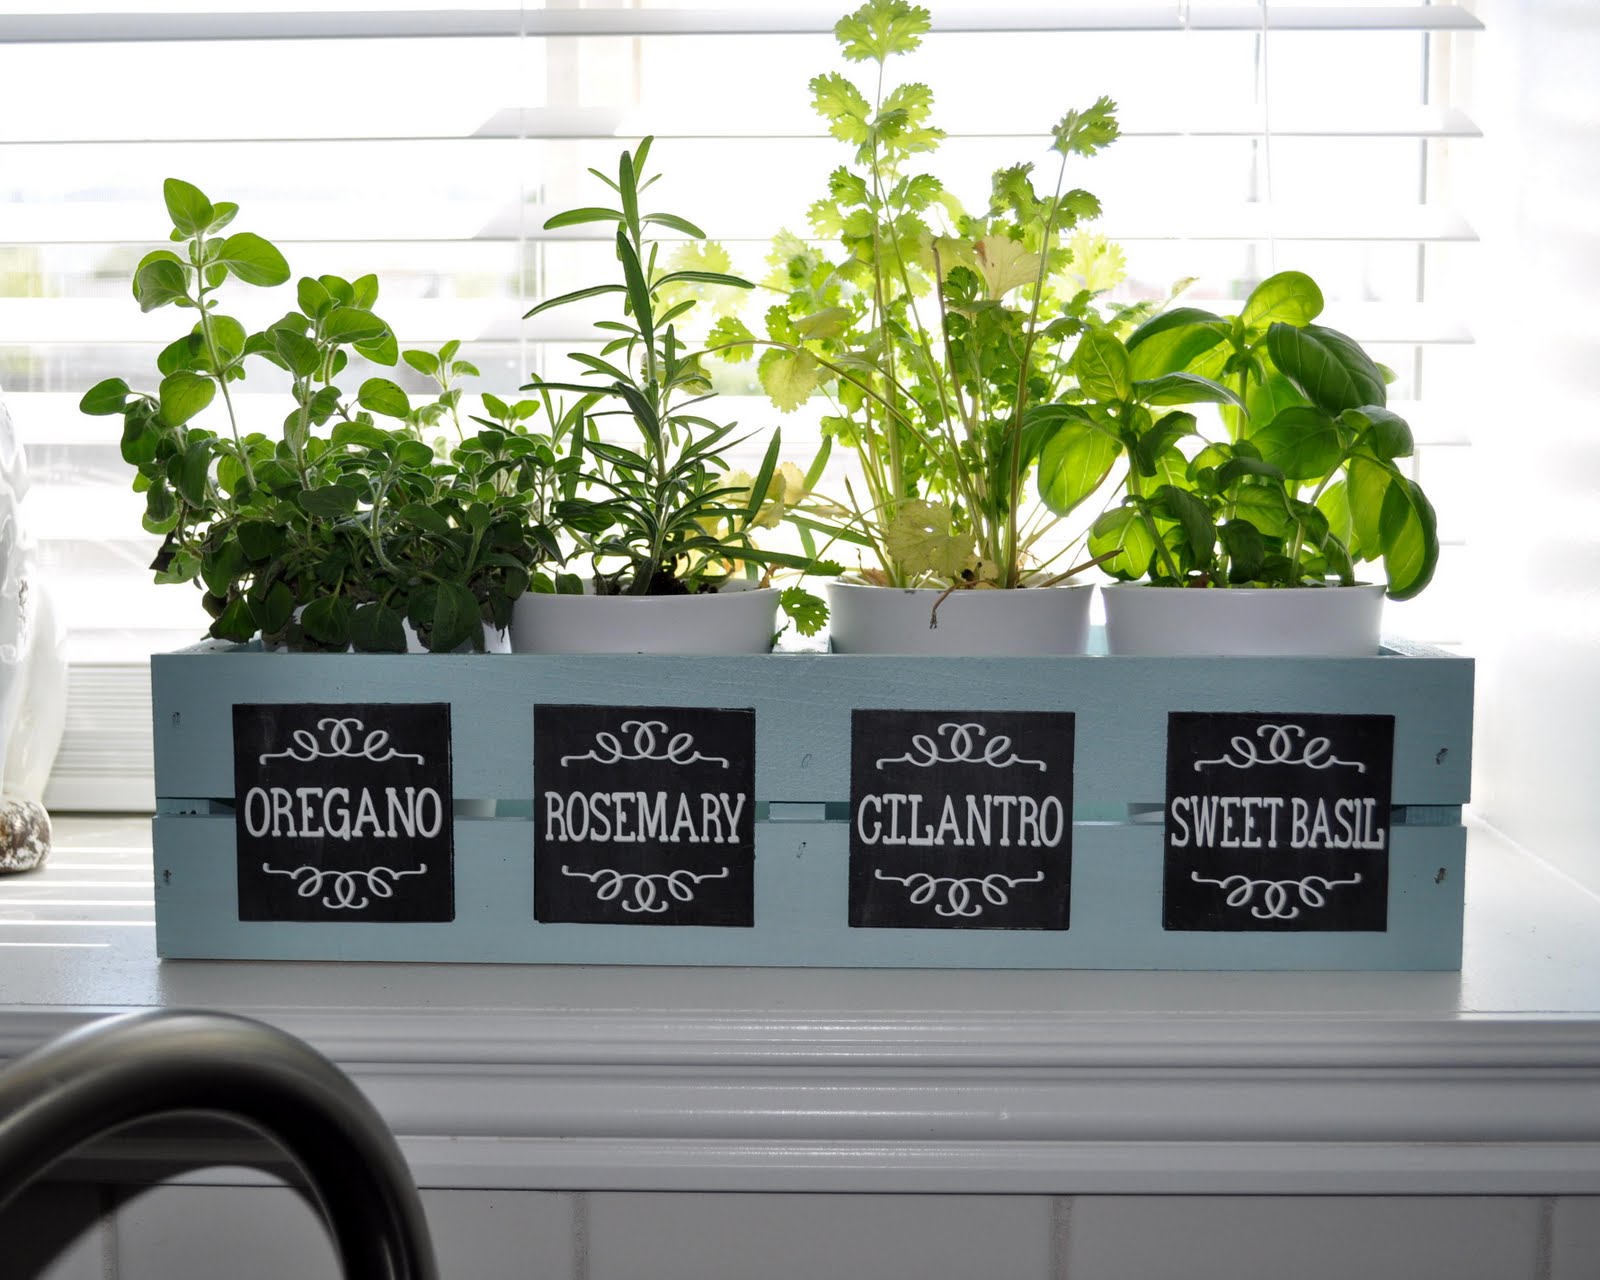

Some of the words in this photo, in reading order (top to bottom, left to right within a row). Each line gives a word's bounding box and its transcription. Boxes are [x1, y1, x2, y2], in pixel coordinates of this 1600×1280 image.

[244, 786, 443, 841] OREGANO
[544, 791, 746, 844] ROSEMARY
[857, 793, 1064, 848] CILANTRO
[1170, 795, 1285, 849] SWEET
[1290, 797, 1385, 850] BASIL
